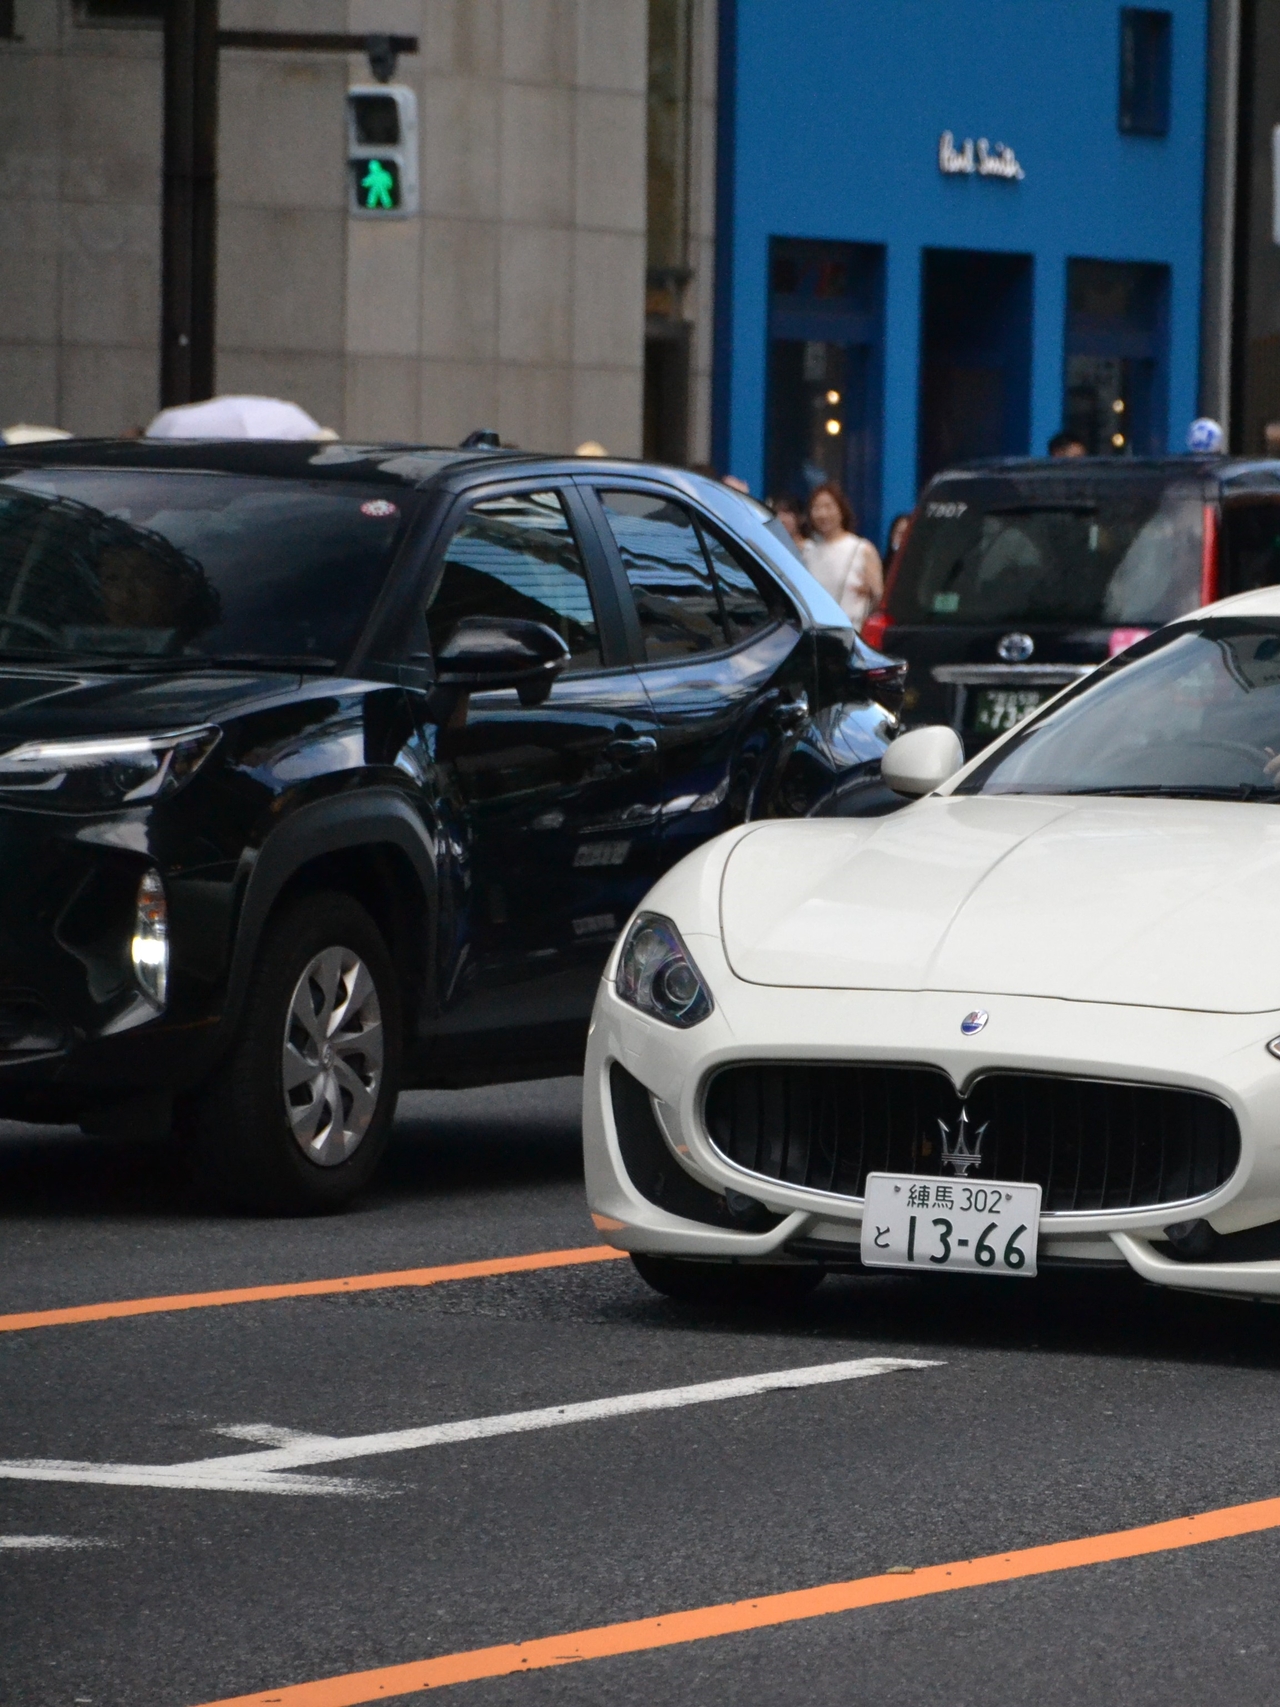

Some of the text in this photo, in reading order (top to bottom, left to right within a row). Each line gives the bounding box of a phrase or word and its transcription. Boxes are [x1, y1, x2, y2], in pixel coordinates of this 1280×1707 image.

[939, 130, 1025, 180] Paul Smith
[907, 1184, 1002, 1214] 練馬 302
[874, 1216, 1028, 1270] と 13-66
